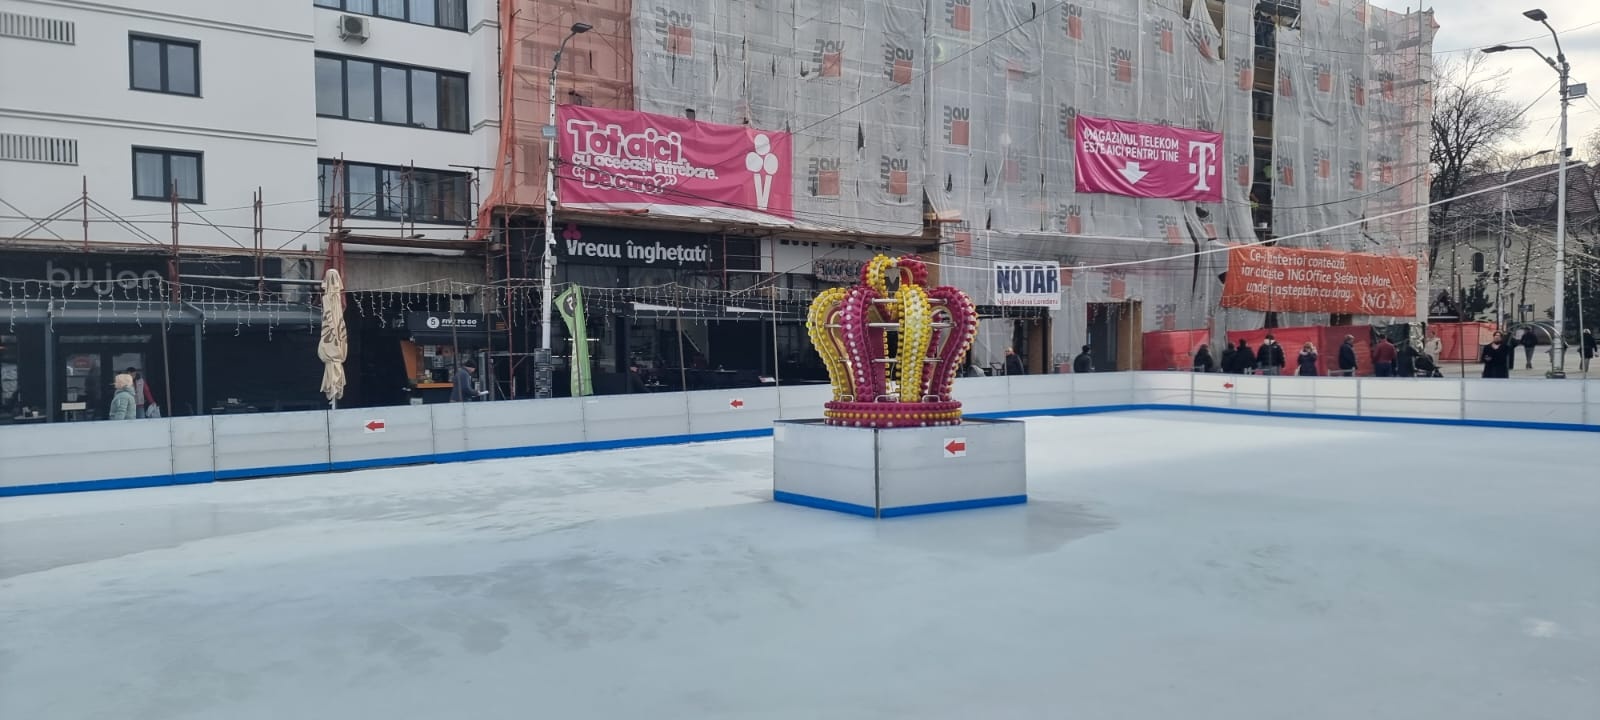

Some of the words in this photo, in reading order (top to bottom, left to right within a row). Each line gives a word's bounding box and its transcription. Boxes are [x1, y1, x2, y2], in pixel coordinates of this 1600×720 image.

[567, 119, 621, 157] Tot
[625, 127, 682, 165] aici
[1083, 127, 1138, 146] MAGAZINUL
[1139, 134, 1179, 151] TELEKOM
[572, 153, 591, 166] cu
[1083, 140, 1105, 154] ESTE
[1107, 144, 1124, 156] AICI
[1125, 146, 1159, 161] PENTRU
[1161, 150, 1179, 162] TINE
[566, 239, 621, 258] Vreau
[997, 265, 1058, 293] NOTAR
[1241, 263, 1253, 276] iar
[1288, 268, 1305, 282] ING
[1306, 269, 1331, 283] Office
[1246, 283, 1267, 295] unde
[1320, 288, 1331, 297] cu
[1362, 292, 1386, 308] ING
